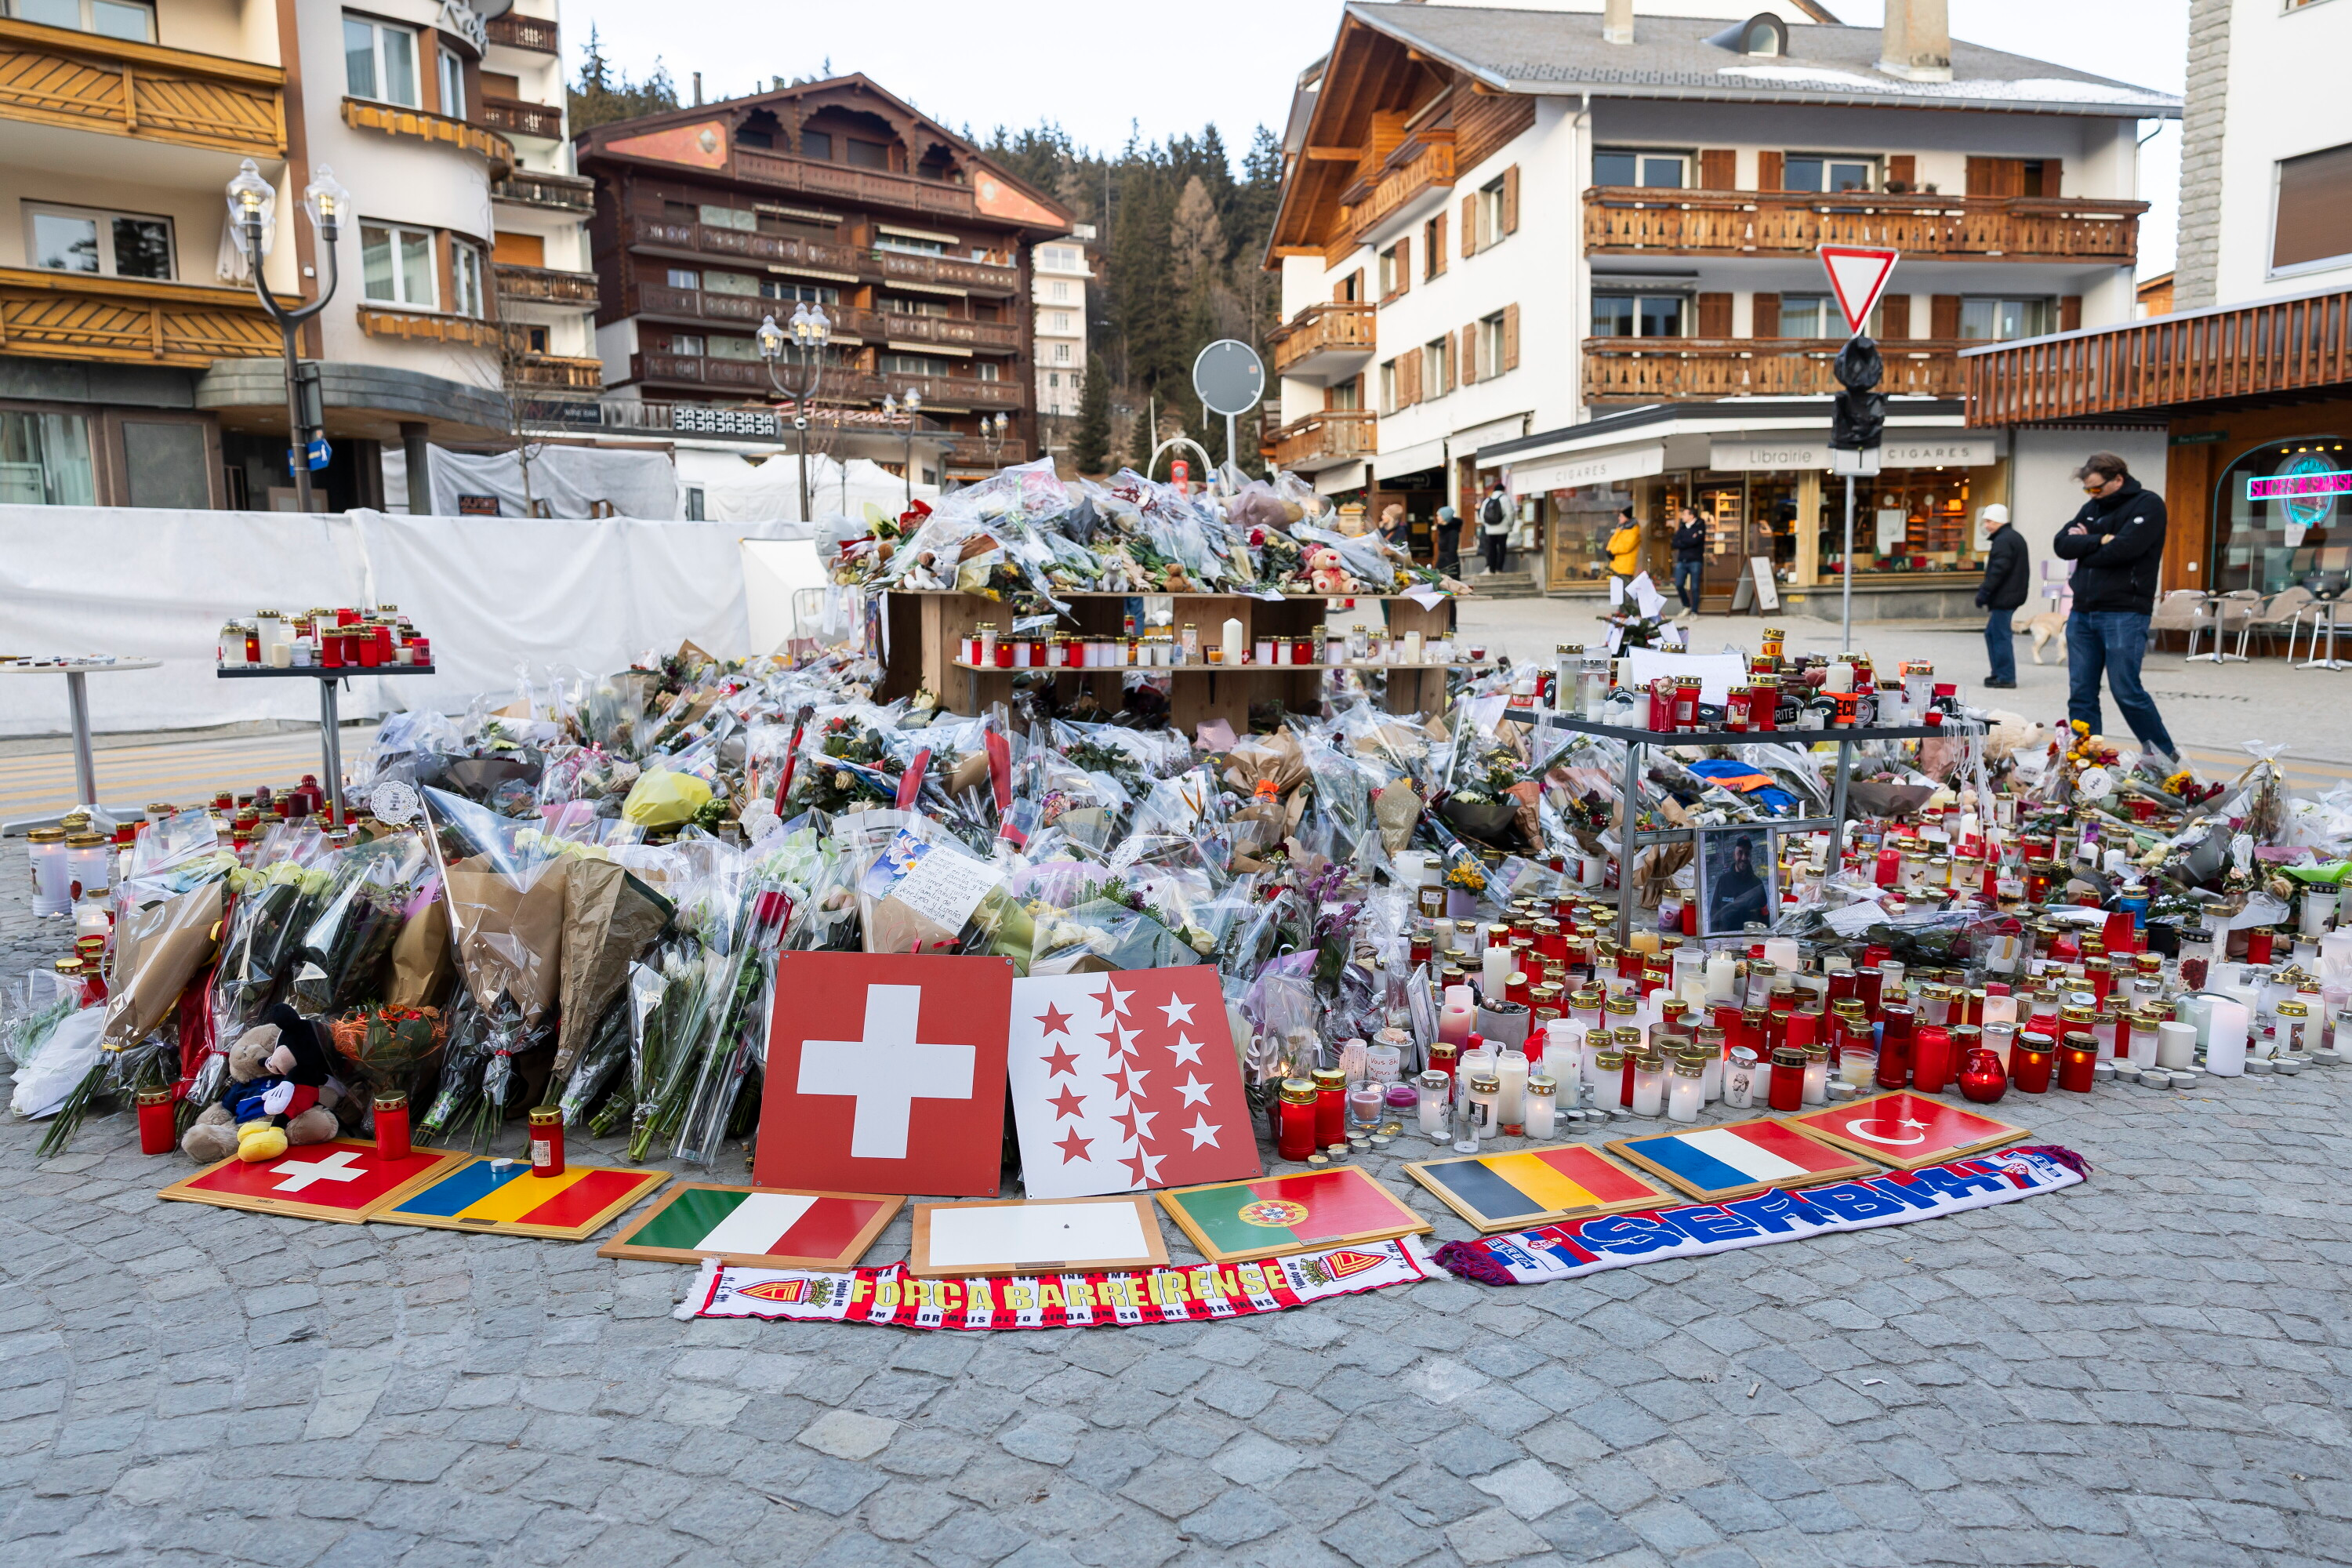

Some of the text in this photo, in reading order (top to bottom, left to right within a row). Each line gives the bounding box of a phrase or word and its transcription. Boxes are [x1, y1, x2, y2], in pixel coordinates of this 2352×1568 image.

[564, 408, 597, 417] WINE BAR
[1749, 449, 1812, 463] Librairie
[1887, 447, 1970, 459] CIGARES
[1555, 464, 1606, 481] CIGARES
[2251, 478, 2295, 496] SLICES
[2297, 477, 2307, 494] &
[1367, 1065, 1391, 1076] toujours
[1572, 1167, 2007, 1255] SERBIA
[865, 1269, 892, 1278] UMA
[1291, 1271, 1308, 1290] Fundado
[837, 1278, 851, 1295] Fundado
[851, 1265, 1288, 1315] FORÇA BARREIRENSE
[865, 1309, 887, 1319] UM
[894, 1312, 940, 1323] VALOR
[947, 1314, 985, 1323] MAIS
[993, 1315, 1031, 1323] ALTO
